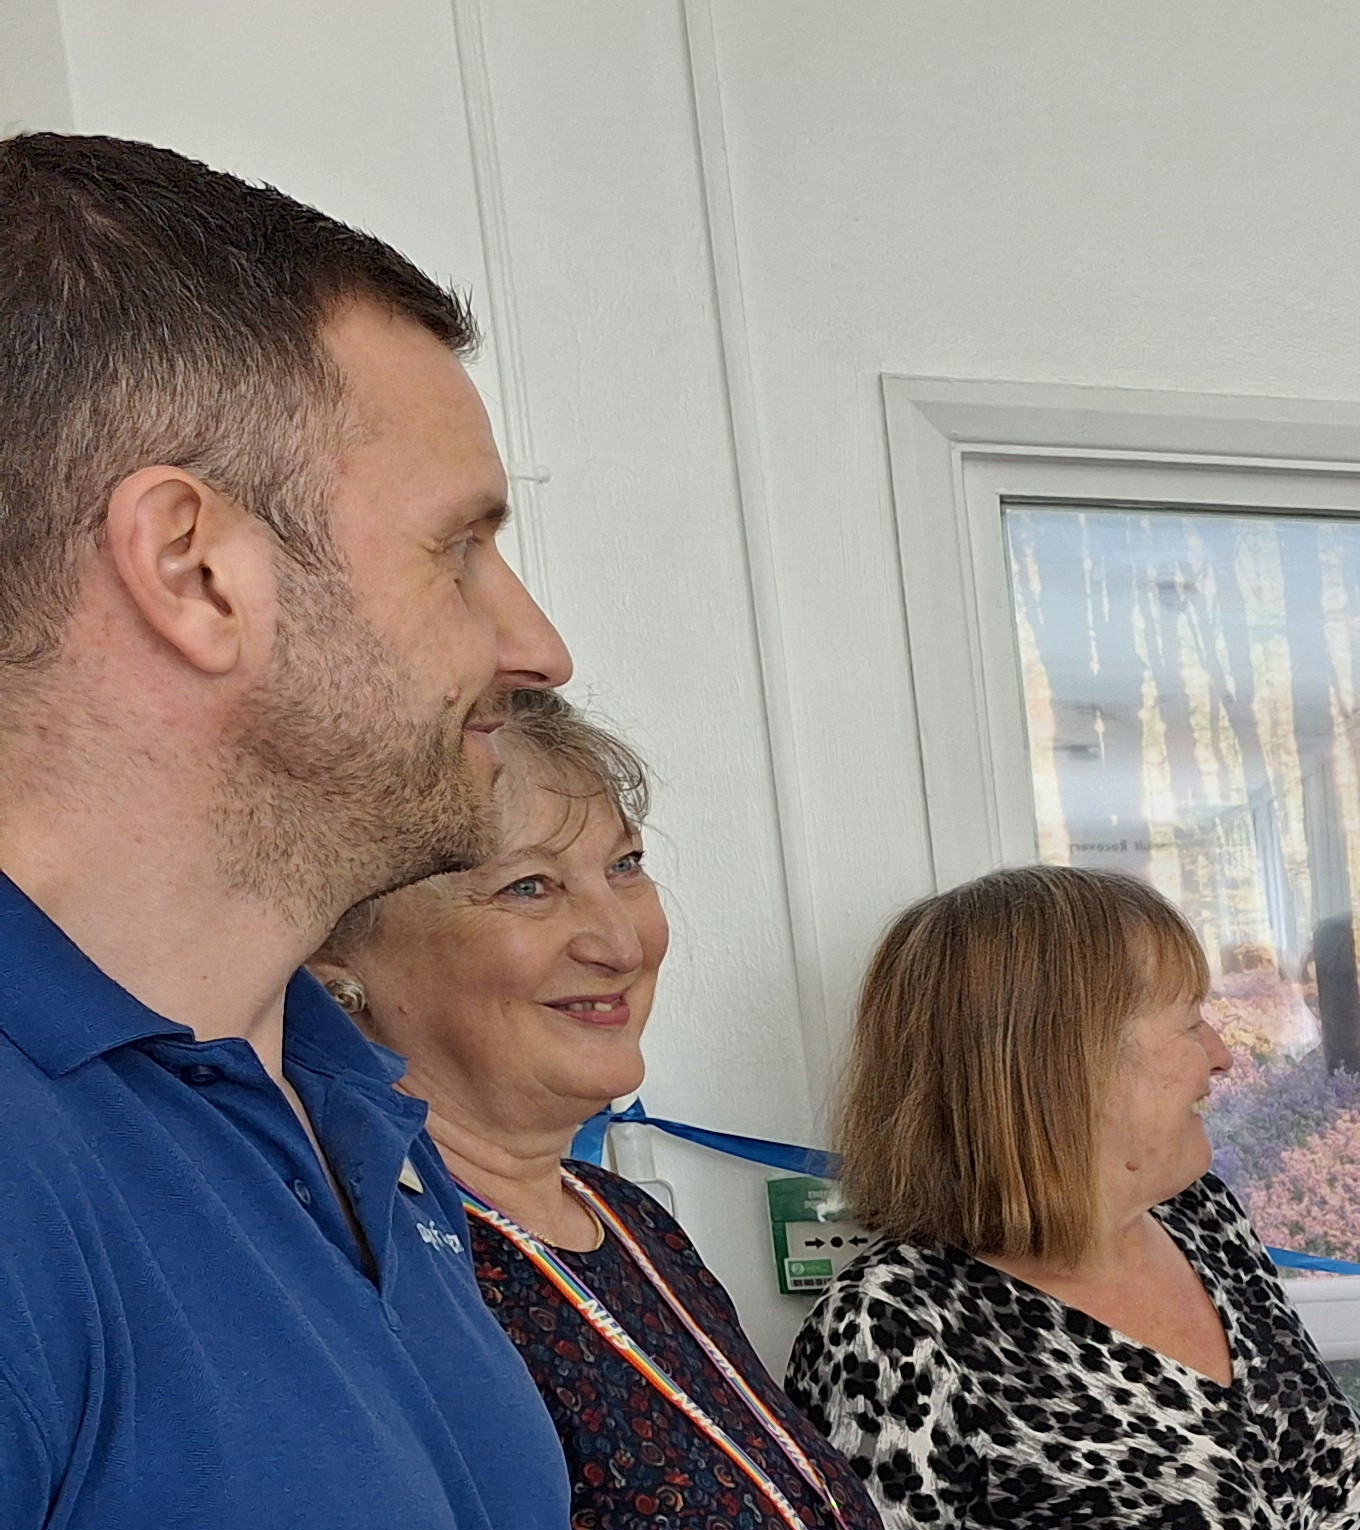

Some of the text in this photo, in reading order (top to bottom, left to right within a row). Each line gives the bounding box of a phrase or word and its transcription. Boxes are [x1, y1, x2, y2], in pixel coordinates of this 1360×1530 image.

[479, 1209, 545, 1255] NHS
[577, 1298, 640, 1351] NHS
[671, 1391, 727, 1438] NHS
